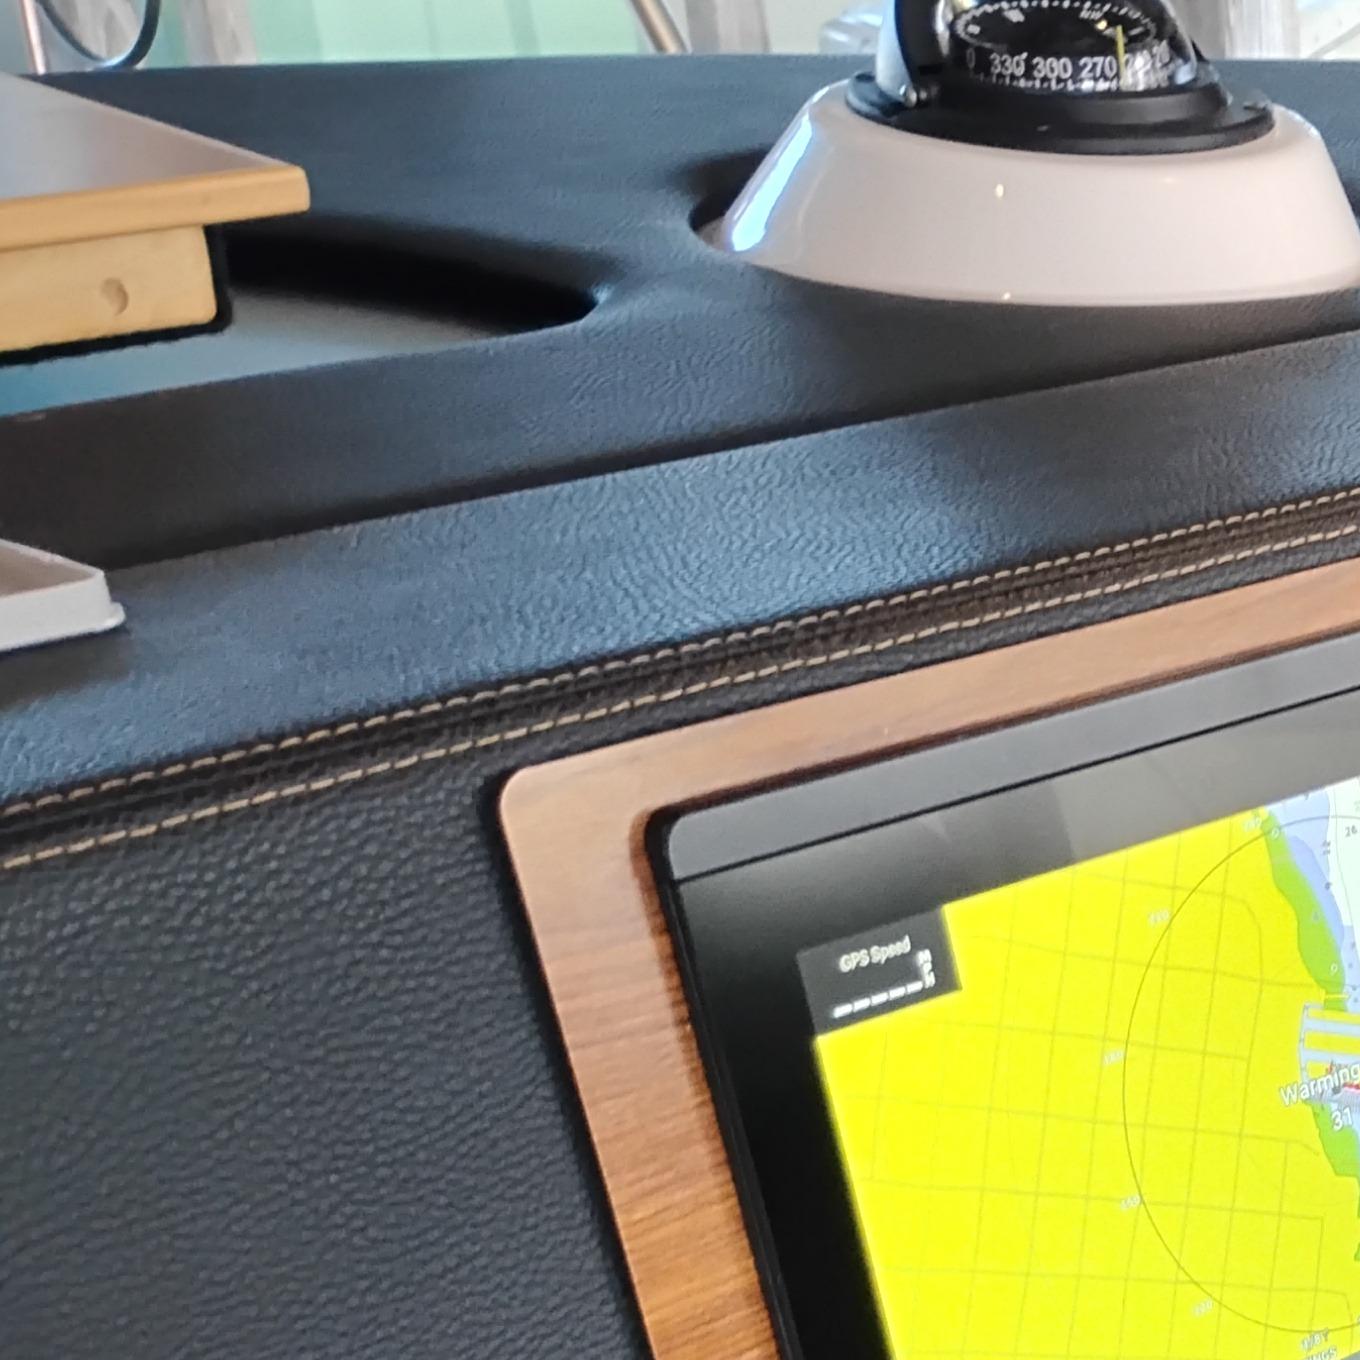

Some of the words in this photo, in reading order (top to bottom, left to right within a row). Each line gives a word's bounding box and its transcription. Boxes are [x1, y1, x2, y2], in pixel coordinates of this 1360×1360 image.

[1033, 57, 1072, 79] 300
[1079, 56, 1117, 78] 270
[839, 948, 870, 973] GPS
[870, 934, 912, 965] Speed
